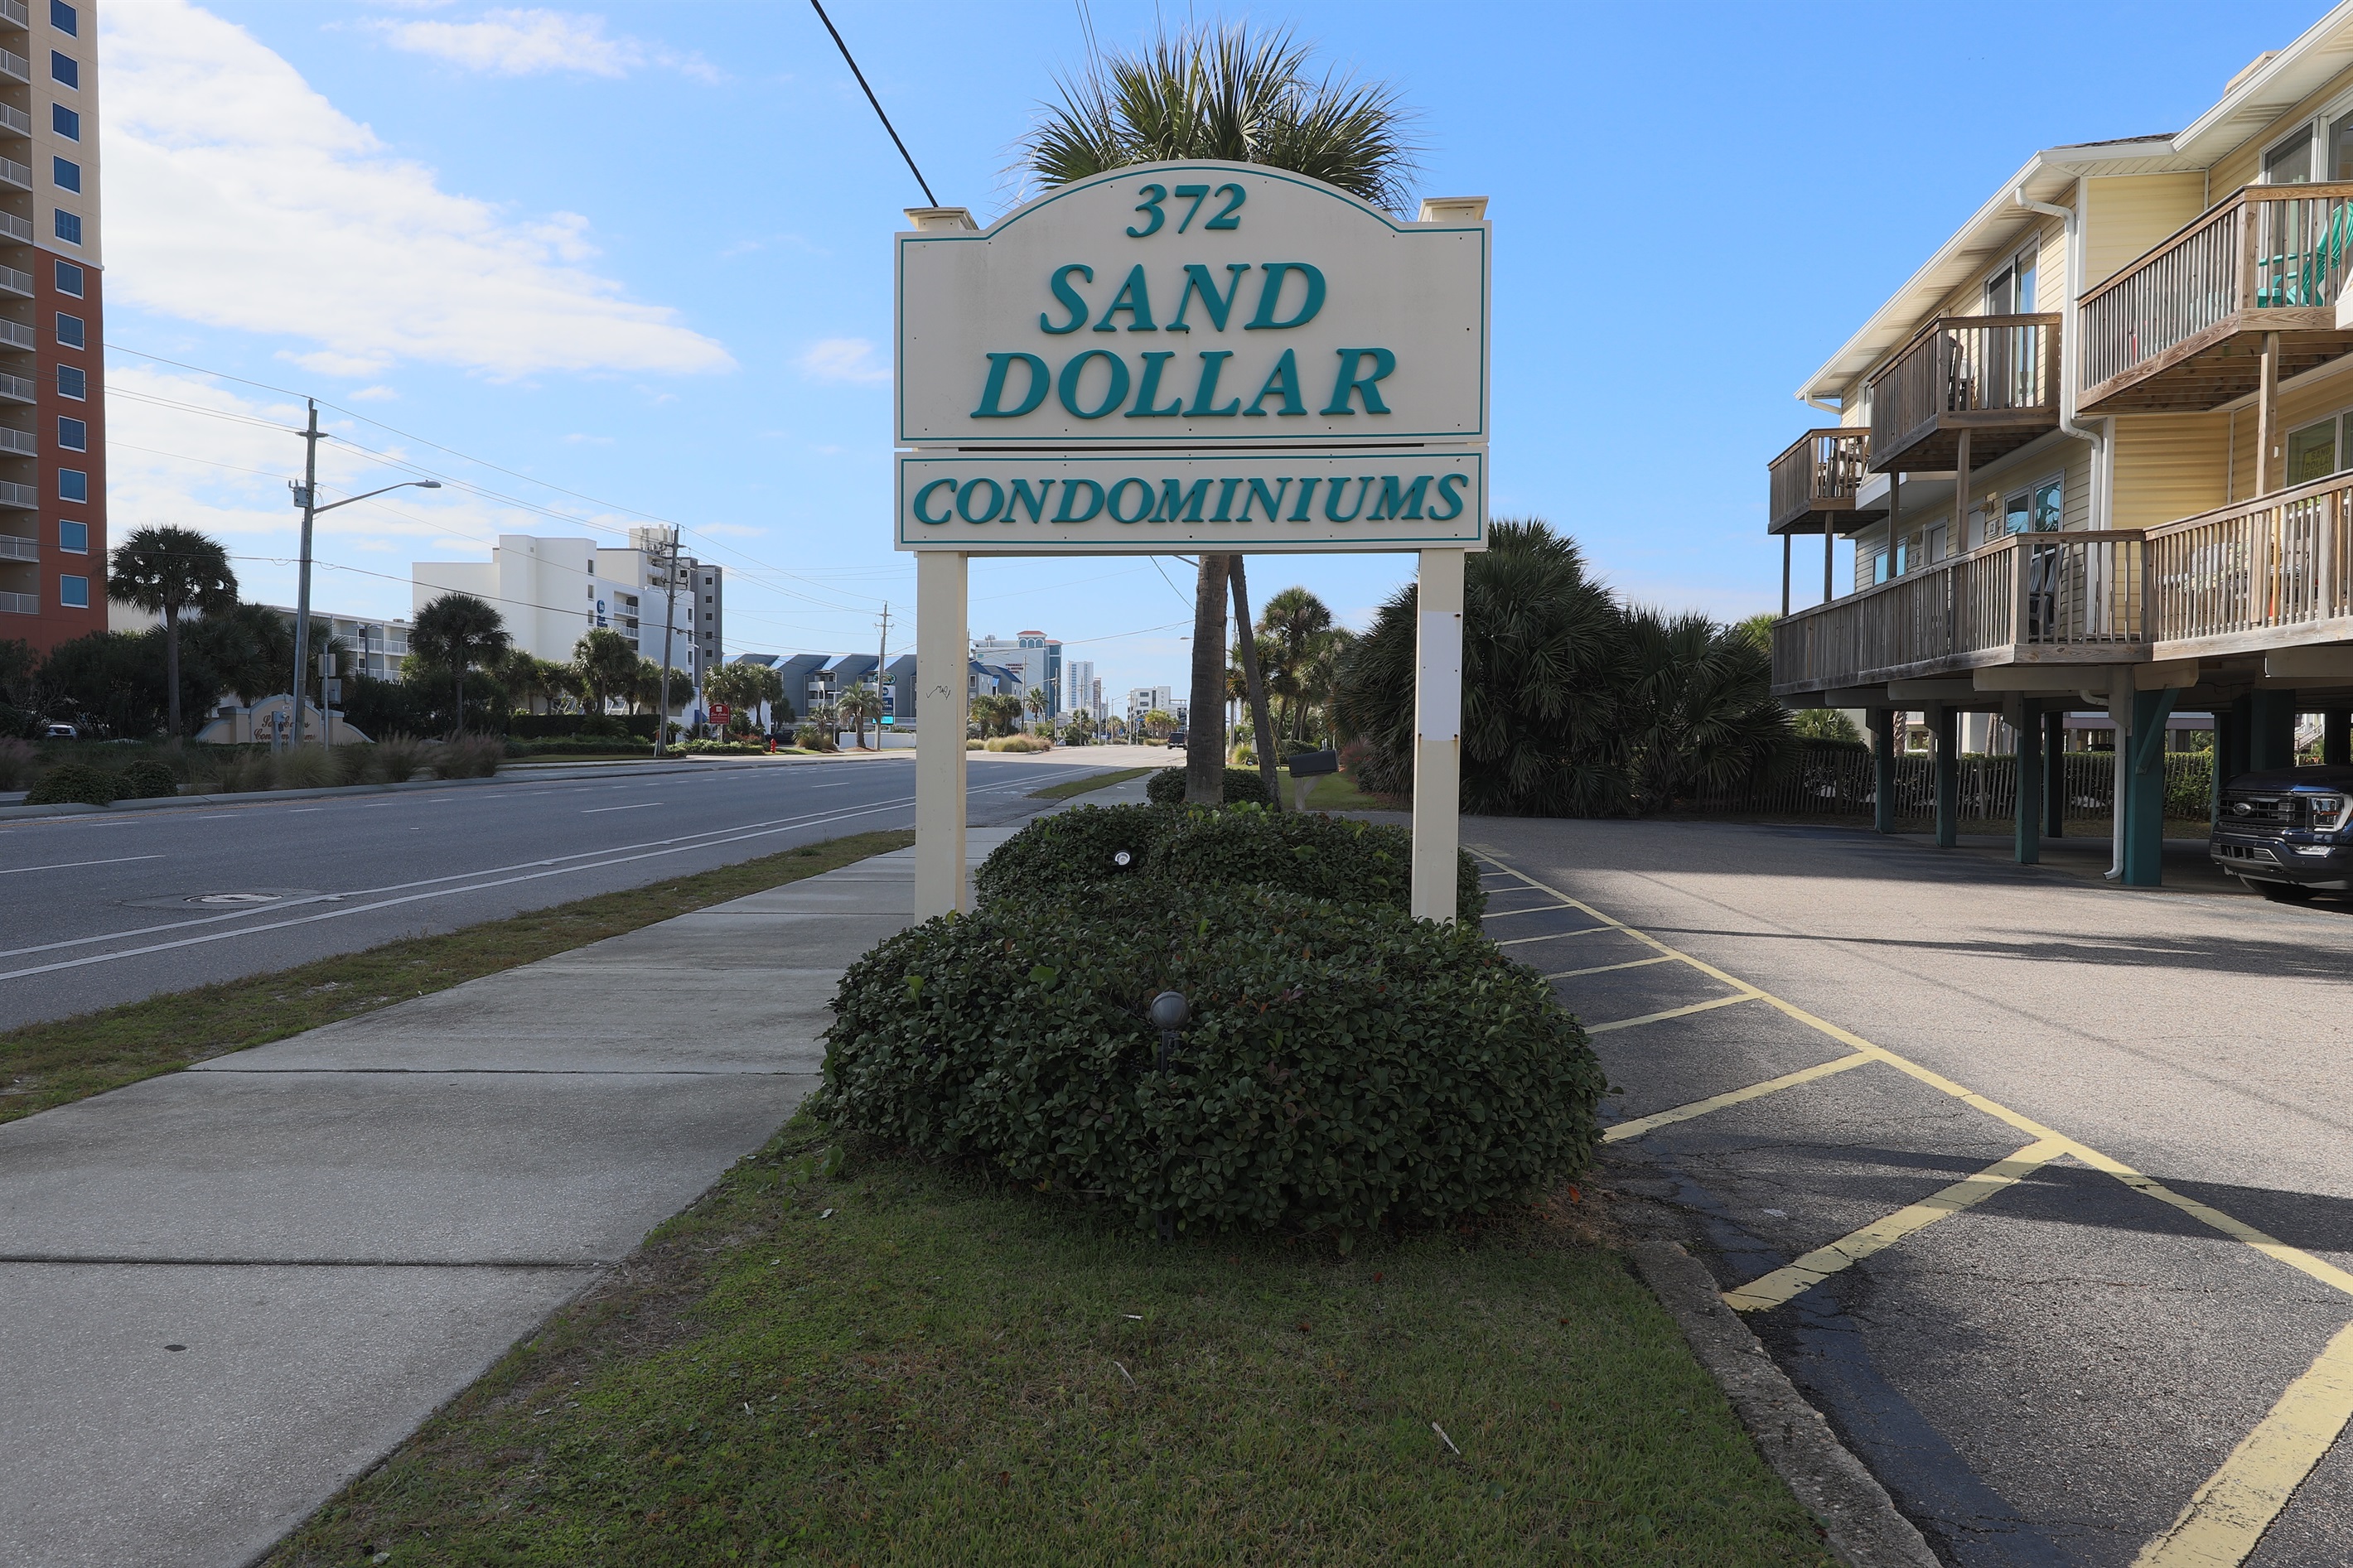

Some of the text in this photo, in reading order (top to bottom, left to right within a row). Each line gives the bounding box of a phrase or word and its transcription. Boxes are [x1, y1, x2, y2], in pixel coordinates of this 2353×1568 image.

[1126, 183, 1246, 238] 372
[1041, 262, 1326, 335] SAND
[970, 348, 1396, 419] DOLLAR
[2303, 464, 2332, 480] RENTAL
[2305, 454, 2333, 471] DOLLAR
[2311, 446, 2331, 460] SAND
[913, 473, 1469, 524] CONDOMINIUMS
